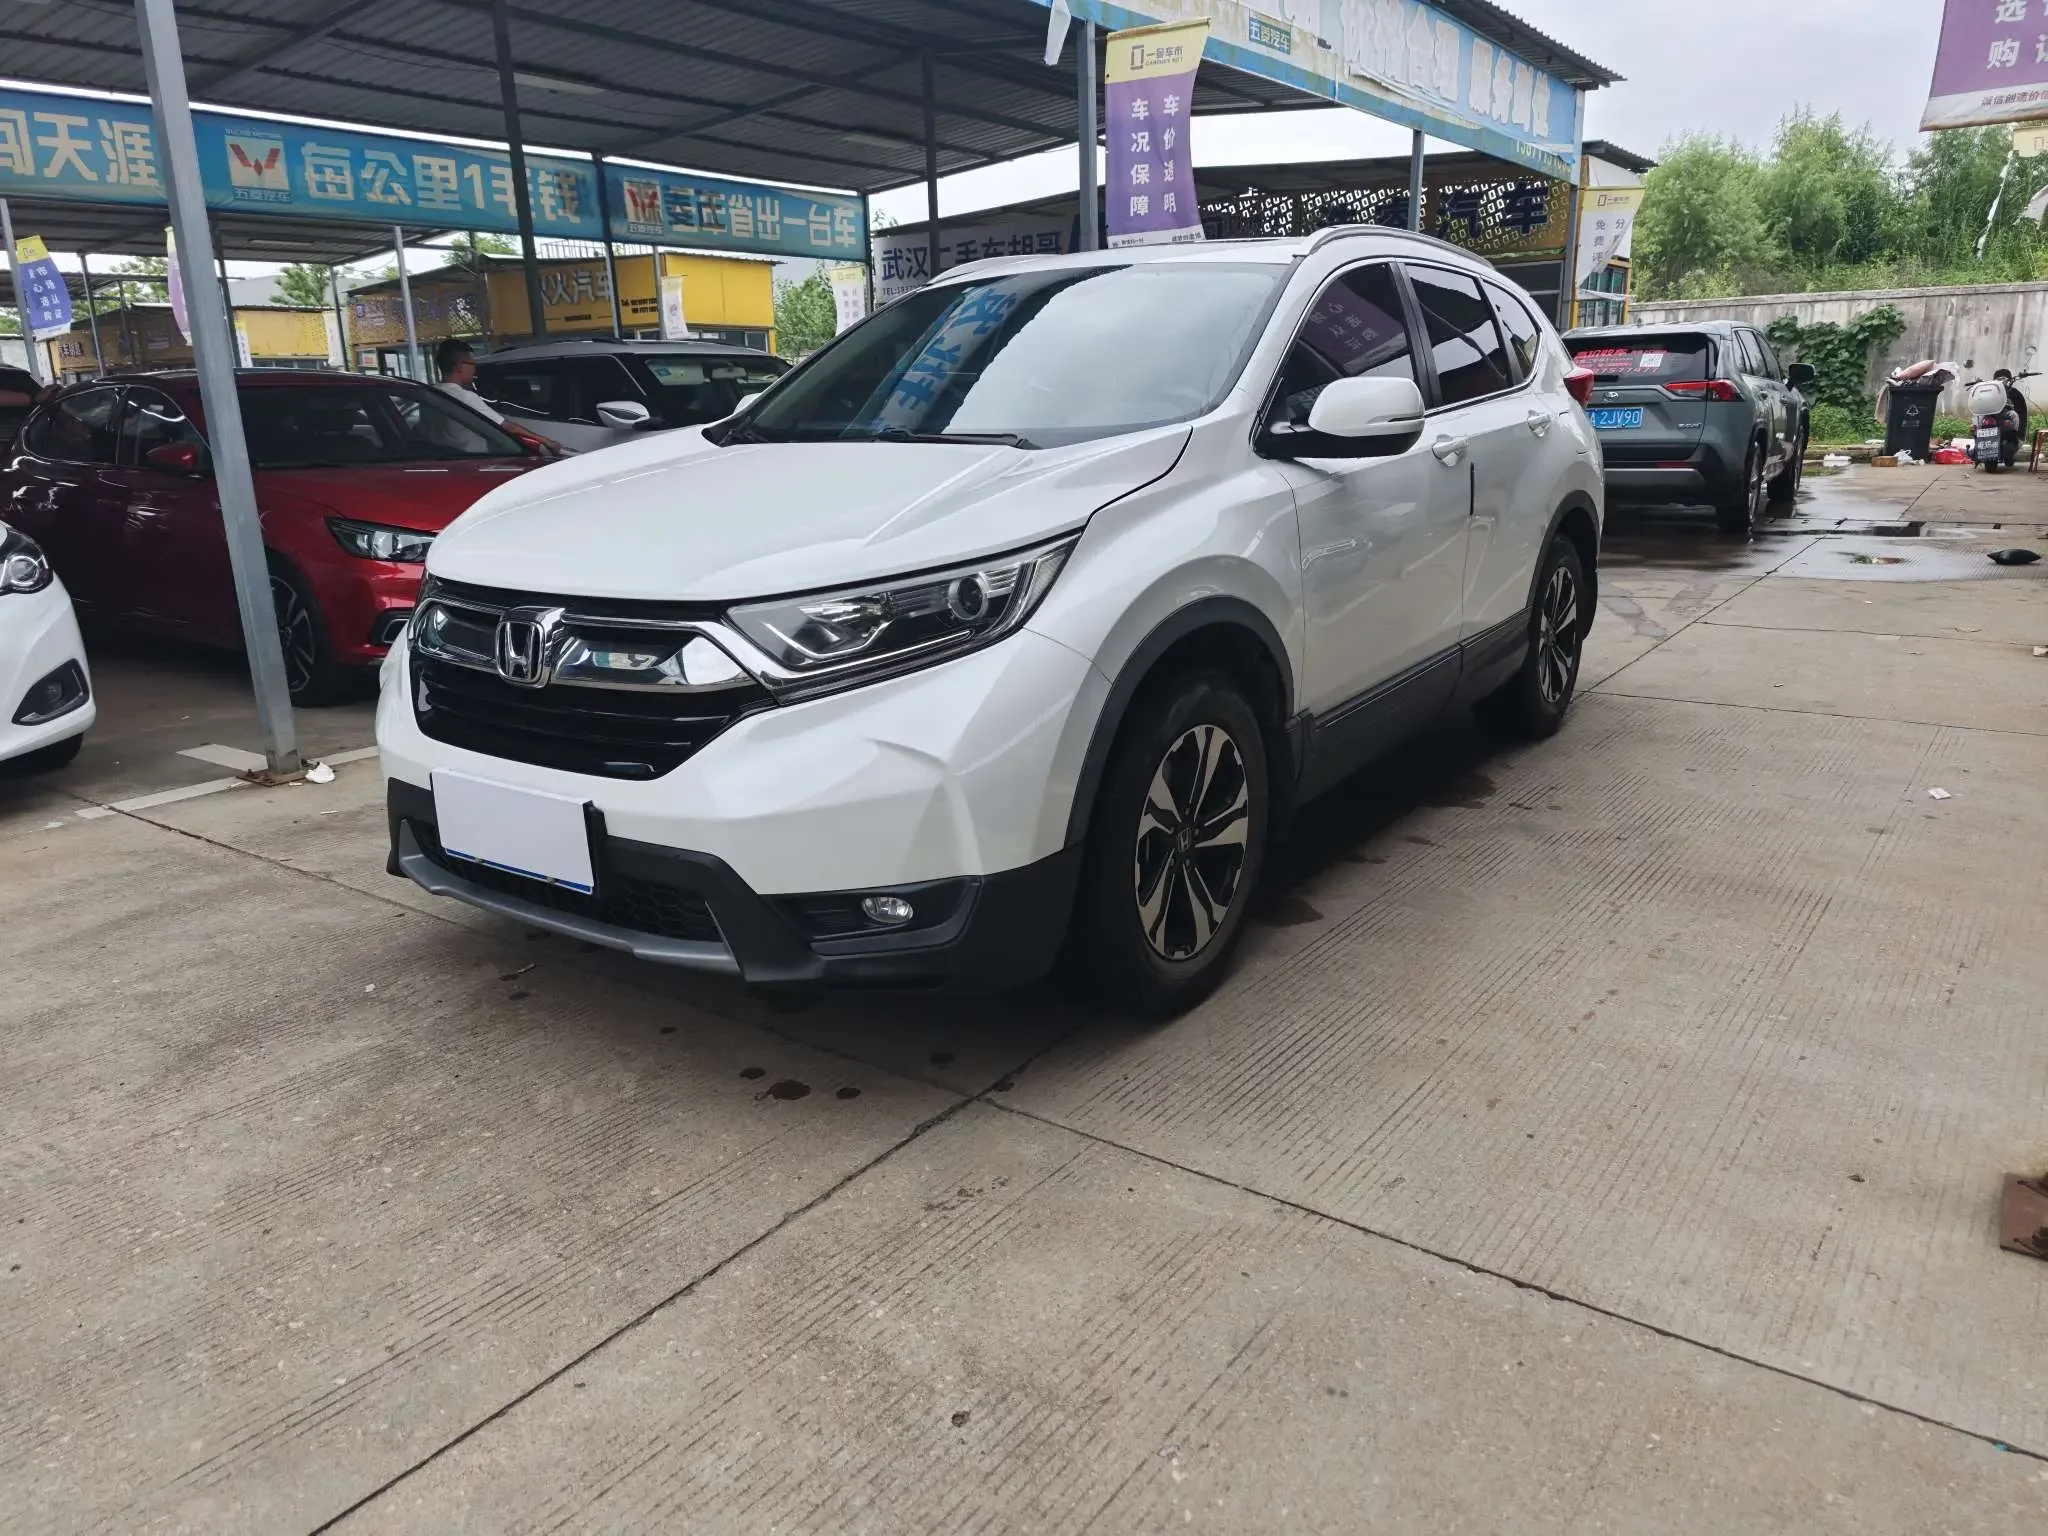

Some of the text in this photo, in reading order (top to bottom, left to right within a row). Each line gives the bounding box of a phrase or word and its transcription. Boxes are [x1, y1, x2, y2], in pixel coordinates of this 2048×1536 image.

[1250, 20, 1291, 52] 五菱汽车
[1129, 98, 1150, 217] 车况保障
[881, 231, 1063, 281] 武汉手车胡哥
